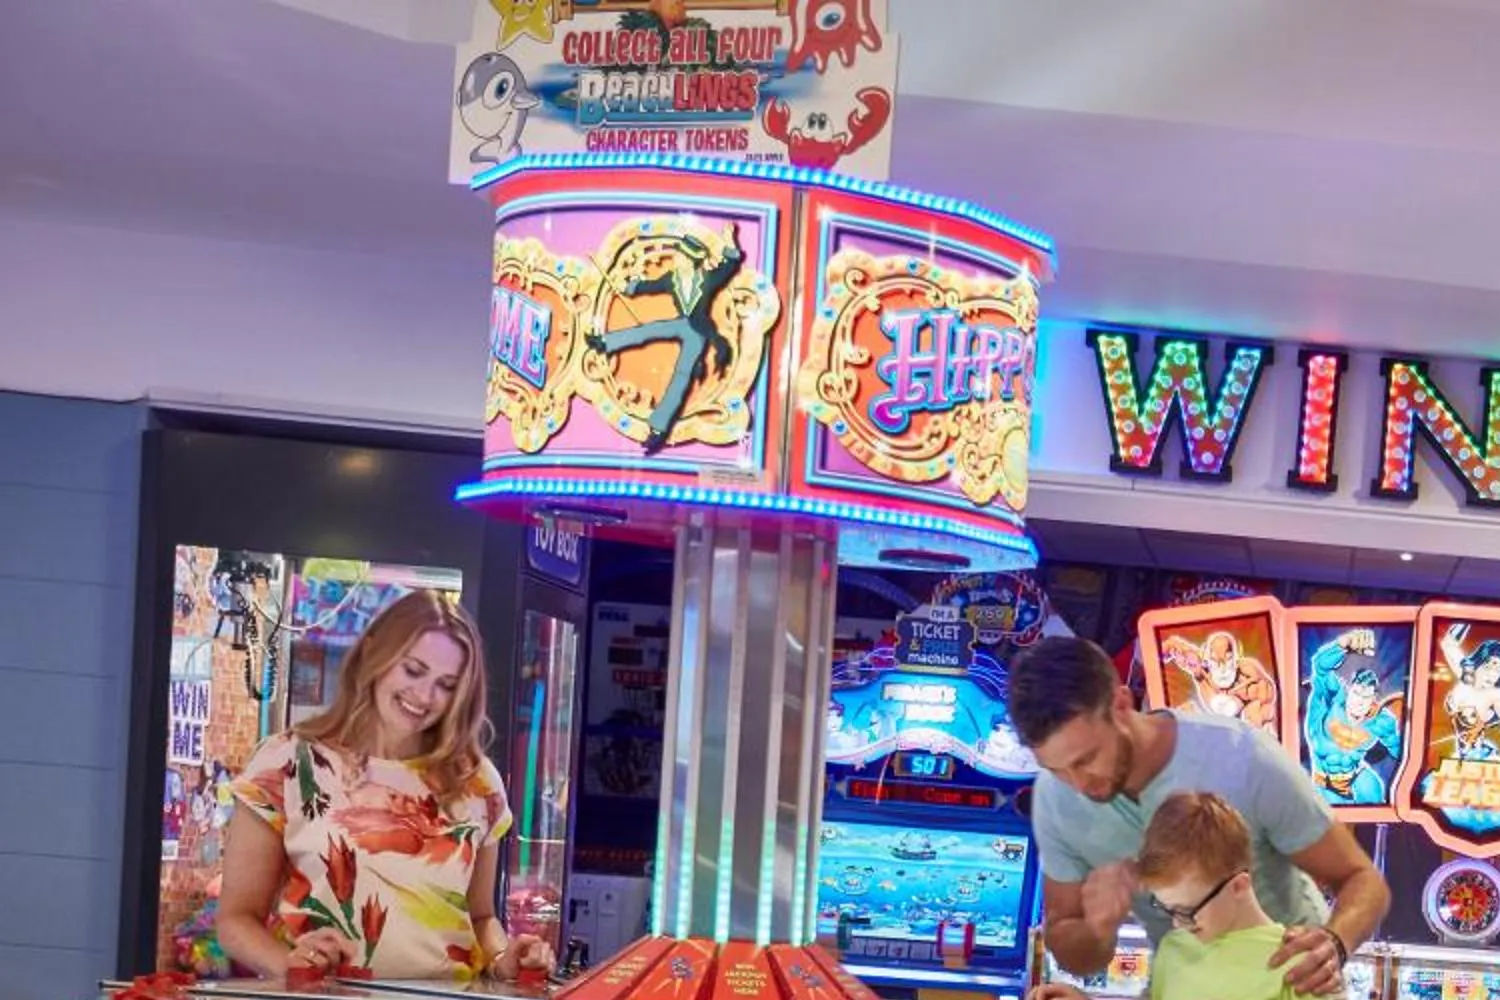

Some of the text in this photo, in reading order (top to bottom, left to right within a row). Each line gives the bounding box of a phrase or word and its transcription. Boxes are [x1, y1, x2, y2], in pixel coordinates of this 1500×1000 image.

[586, 128, 749, 151] CHARACTER TOKENS
[911, 622, 961, 640] TICKET
[908, 653, 958, 664] machine
[172, 682, 208, 719] WIN
[173, 721, 203, 757] ME
